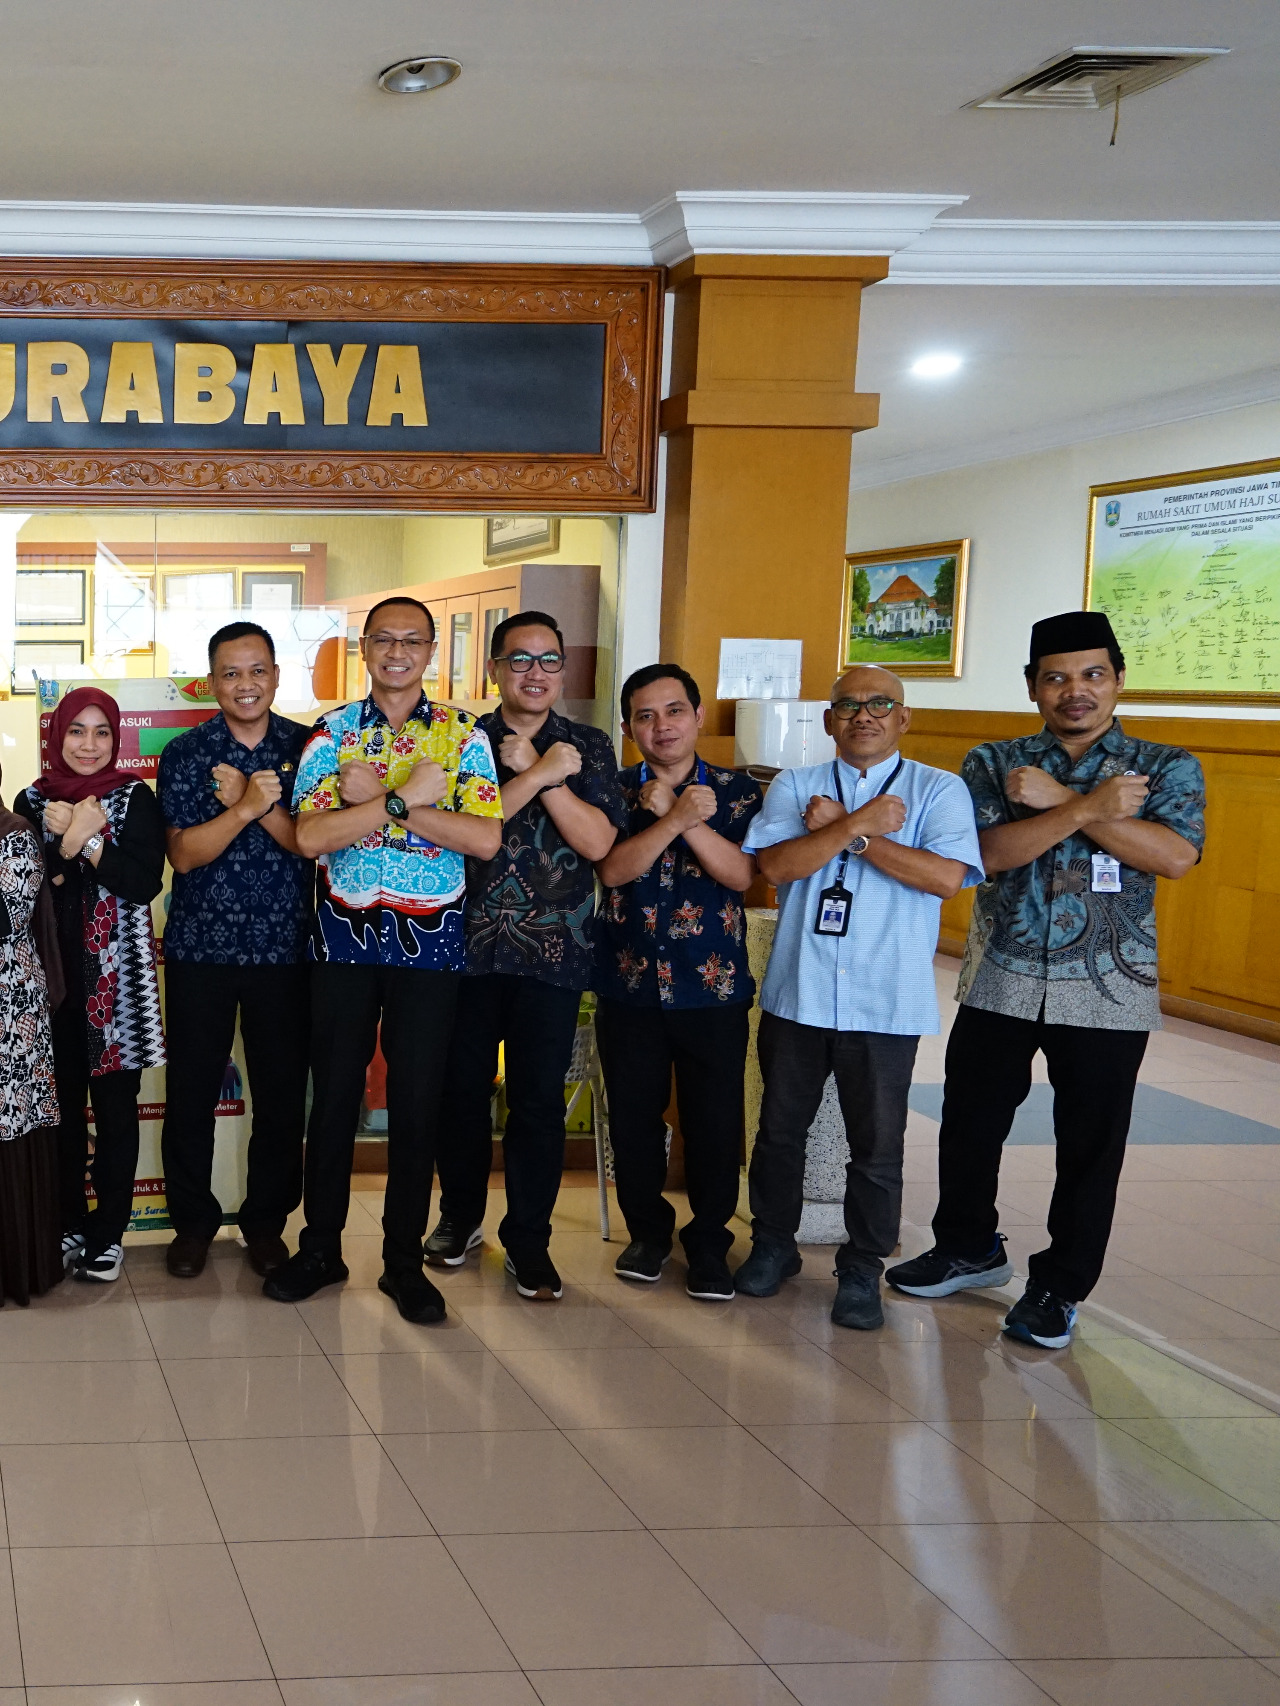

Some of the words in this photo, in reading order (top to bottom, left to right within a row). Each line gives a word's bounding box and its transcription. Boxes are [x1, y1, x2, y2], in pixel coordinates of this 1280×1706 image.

[1164, 492, 1208, 504] PEMERINTAH
[1210, 486, 1245, 497] PROVINSI
[1247, 483, 1269, 493] JAWA
[1137, 508, 1171, 521] RUMAH
[1173, 504, 1201, 517] SAKIT
[1204, 499, 1237, 512] UMUM
[1240, 496, 1264, 507] HAJI
[1267, 494, 1280, 504] SU
[1210, 527, 1231, 535] SEGALA
[1232, 524, 1254, 532] SITUASI
[120, 717, 152, 727] ASUKI
[115, 758, 155, 768] ANGAN
[132, 1183, 151, 1193] atuk
[152, 1183, 159, 1192] &
[131, 1207, 142, 1218] aji
